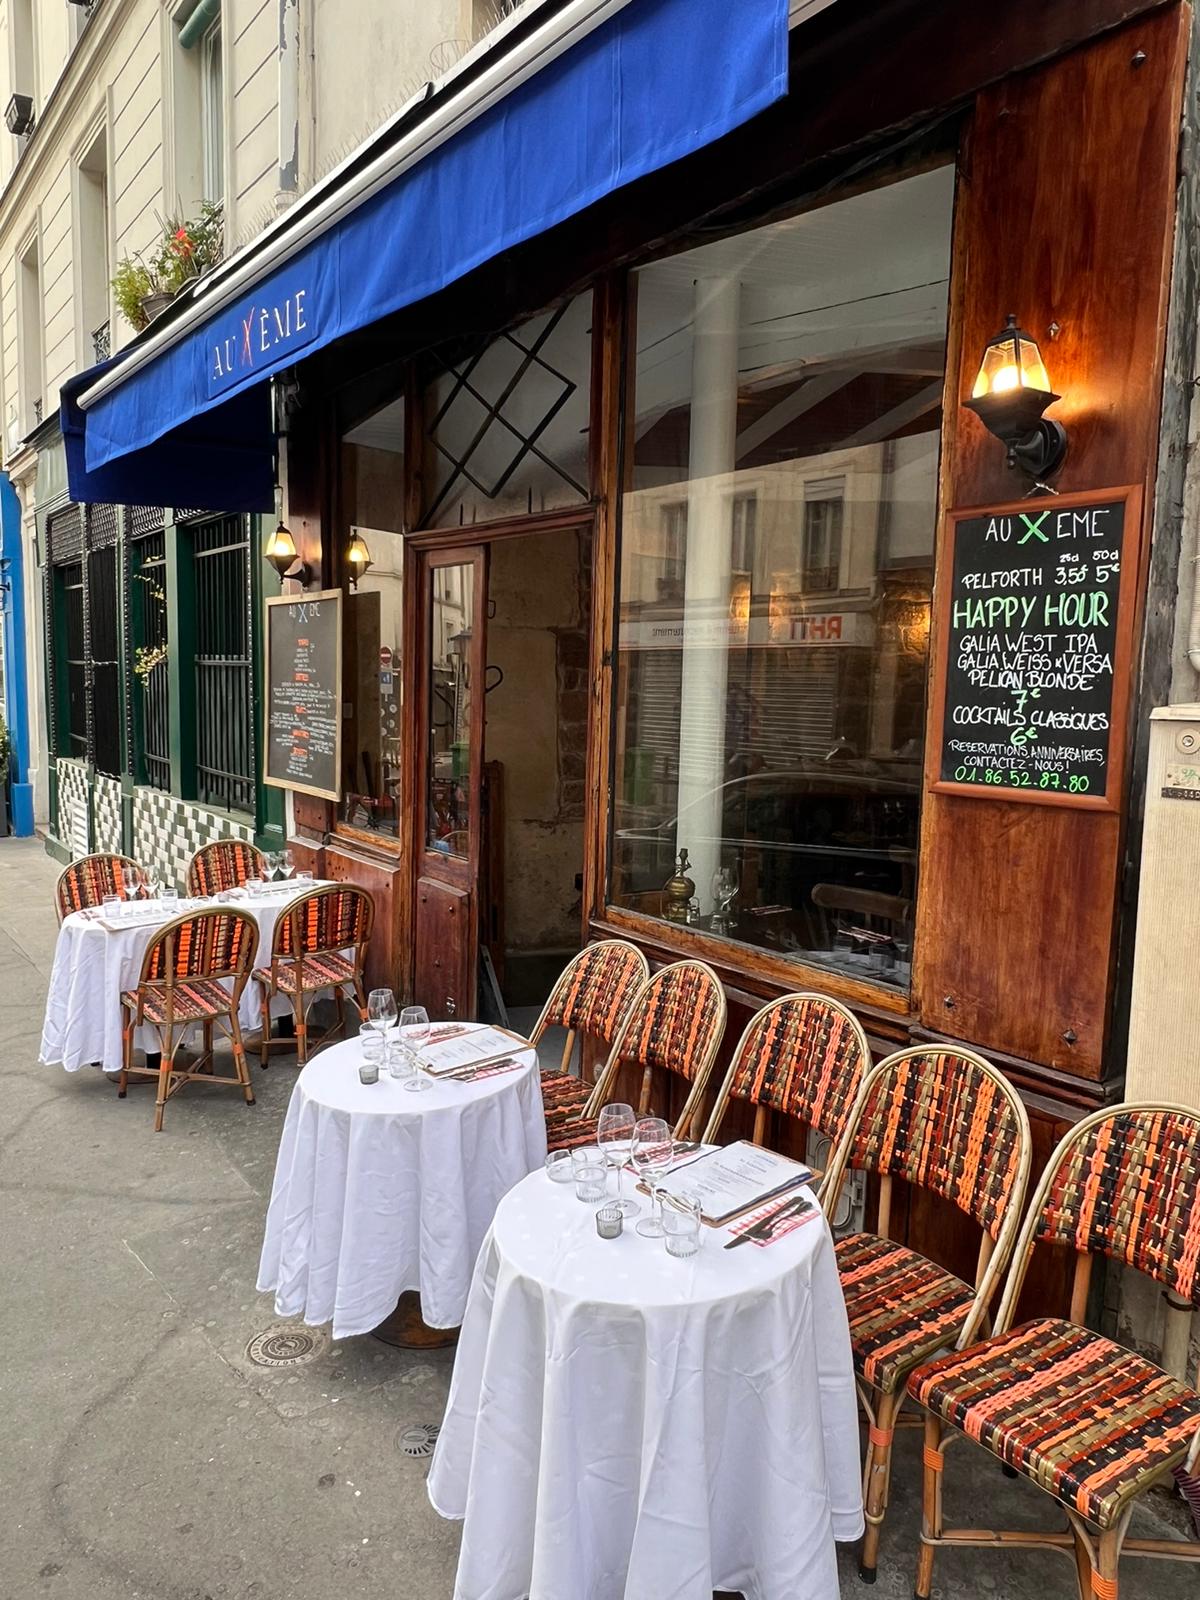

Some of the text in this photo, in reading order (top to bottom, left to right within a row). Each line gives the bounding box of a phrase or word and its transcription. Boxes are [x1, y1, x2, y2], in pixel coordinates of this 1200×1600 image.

[985, 509, 1110, 544] AU X EME
[961, 567, 1043, 590] PELFORTH
[953, 590, 1110, 629] HAPPY HOUR
[959, 631, 1098, 656] GALIA WEST IPA
[957, 653, 1000, 671] GALIA
[1024, 671, 1095, 691] BLONDE
[953, 702, 1109, 731] COCKTAILS CLASSIQUES
[1010, 727, 1039, 746] 6€
